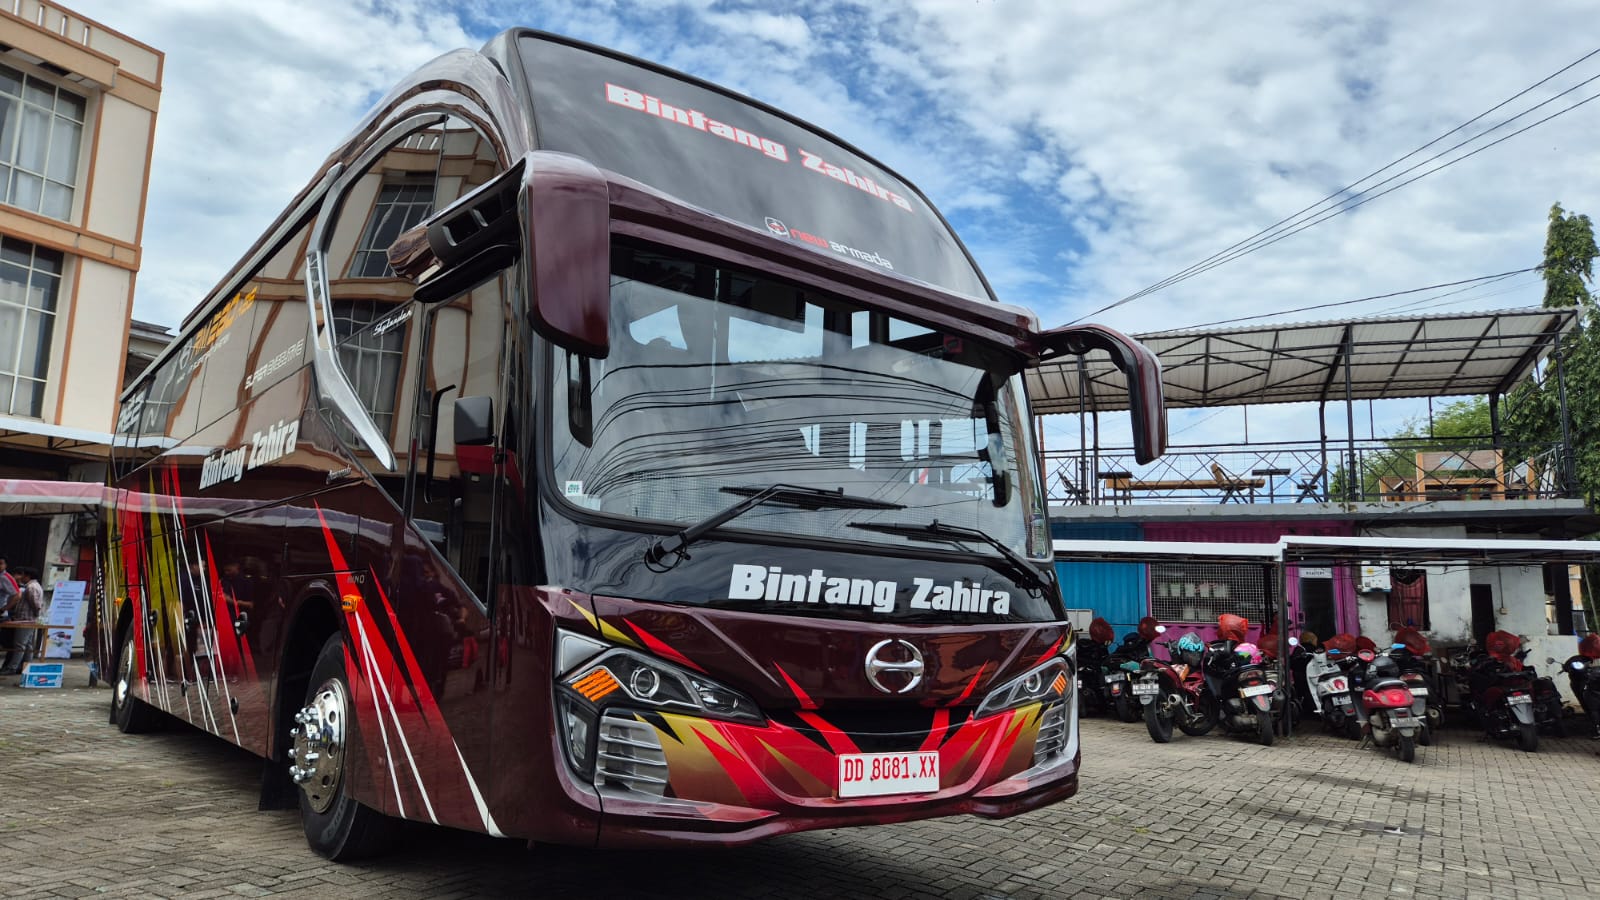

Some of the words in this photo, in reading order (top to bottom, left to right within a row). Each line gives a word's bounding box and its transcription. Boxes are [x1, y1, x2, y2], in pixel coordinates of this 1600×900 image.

[605, 82, 789, 163] Bintang
[799, 148, 913, 213] Zahira
[790, 229, 829, 250] new
[829, 240, 893, 270] armada
[199, 445, 247, 490] Bintang
[247, 419, 299, 471] Zahira
[728, 563, 898, 613] Bintang
[910, 577, 1010, 615] Zahira
[844, 758, 864, 782] DD
[919, 755, 936, 778] XX
